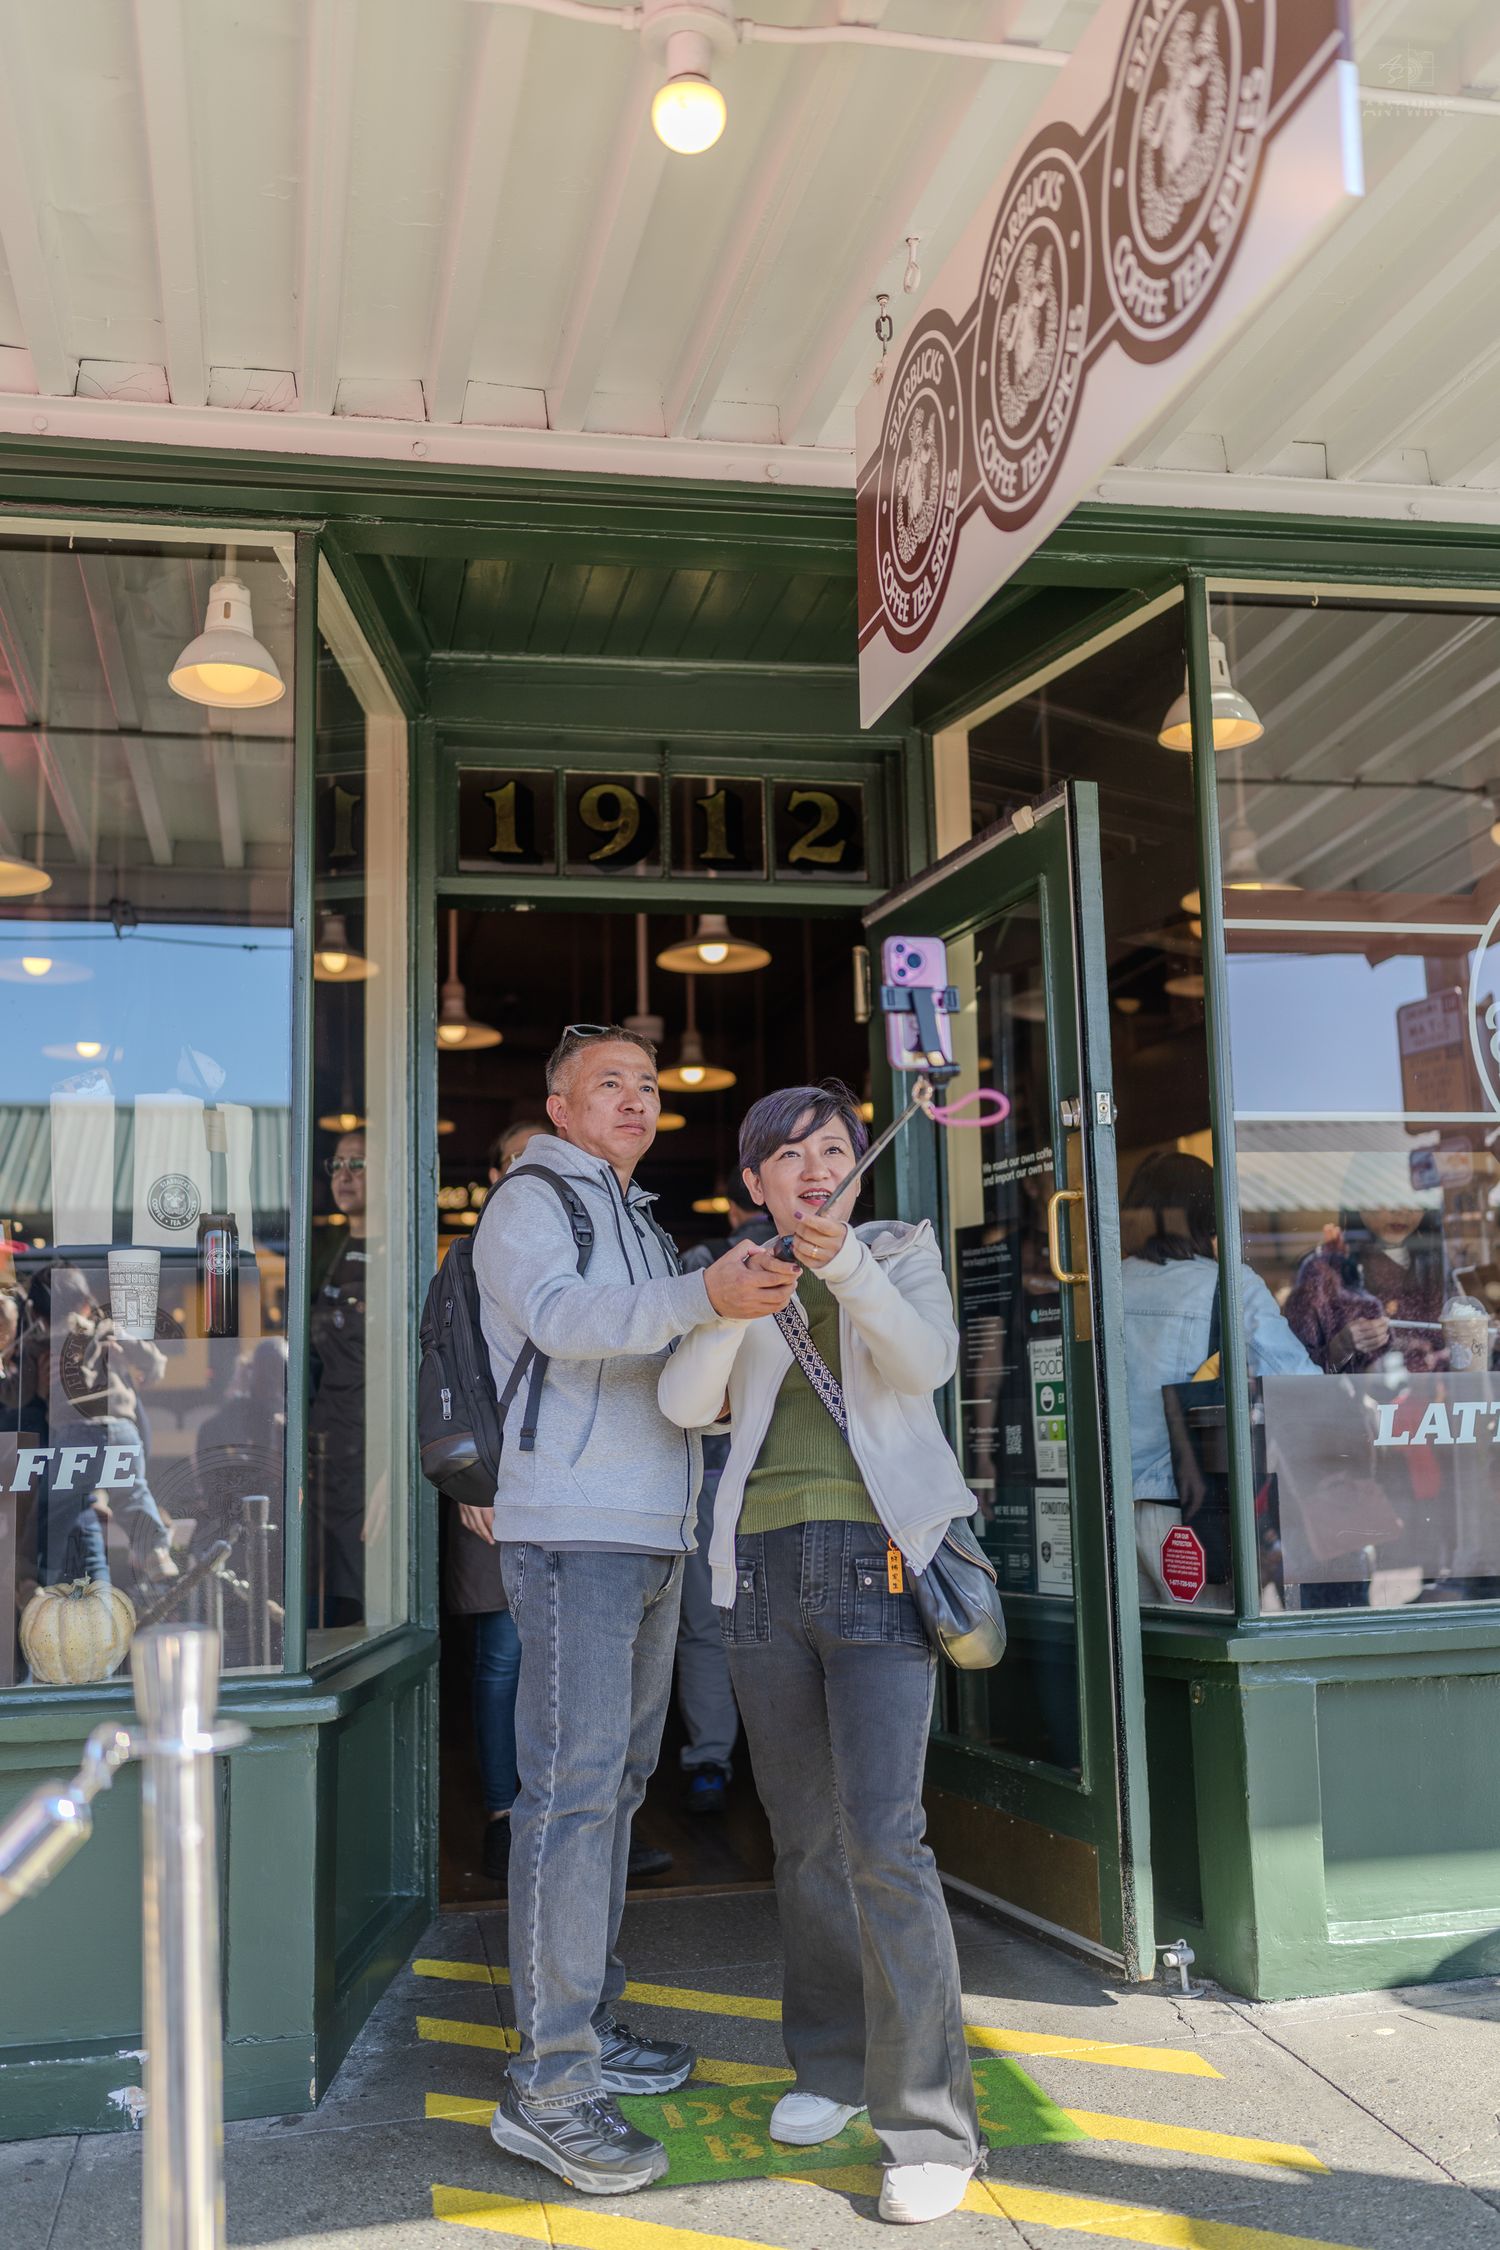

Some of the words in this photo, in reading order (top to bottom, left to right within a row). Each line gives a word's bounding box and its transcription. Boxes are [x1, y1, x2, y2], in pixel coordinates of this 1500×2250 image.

[1115, 235, 1169, 323] COFFEE
[1171, 240, 1214, 311] TEA
[1209, 66, 1265, 246] SPICES
[989, 169, 1065, 300] STARBUCKS
[889, 348, 945, 450] STARBUCKS
[980, 418, 1018, 497] COFFEE
[1021, 437, 1049, 491] TEA
[1046, 303, 1085, 444] SPICES
[882, 551, 910, 623] COFFEE
[912, 575, 932, 620] TEA
[931, 468, 959, 582] SPICES
[995, 1170, 1014, 1185] import
[1016, 1168, 1027, 1178] our
[1028, 1163, 1043, 1175] own
[1009, 1156, 1020, 1167] our
[1021, 1152, 1035, 1164] own
[170, 1219, 182, 1227] TEA
[1033, 1359, 1063, 1376] FOOD
[0, 1445, 141, 1492] FFE
